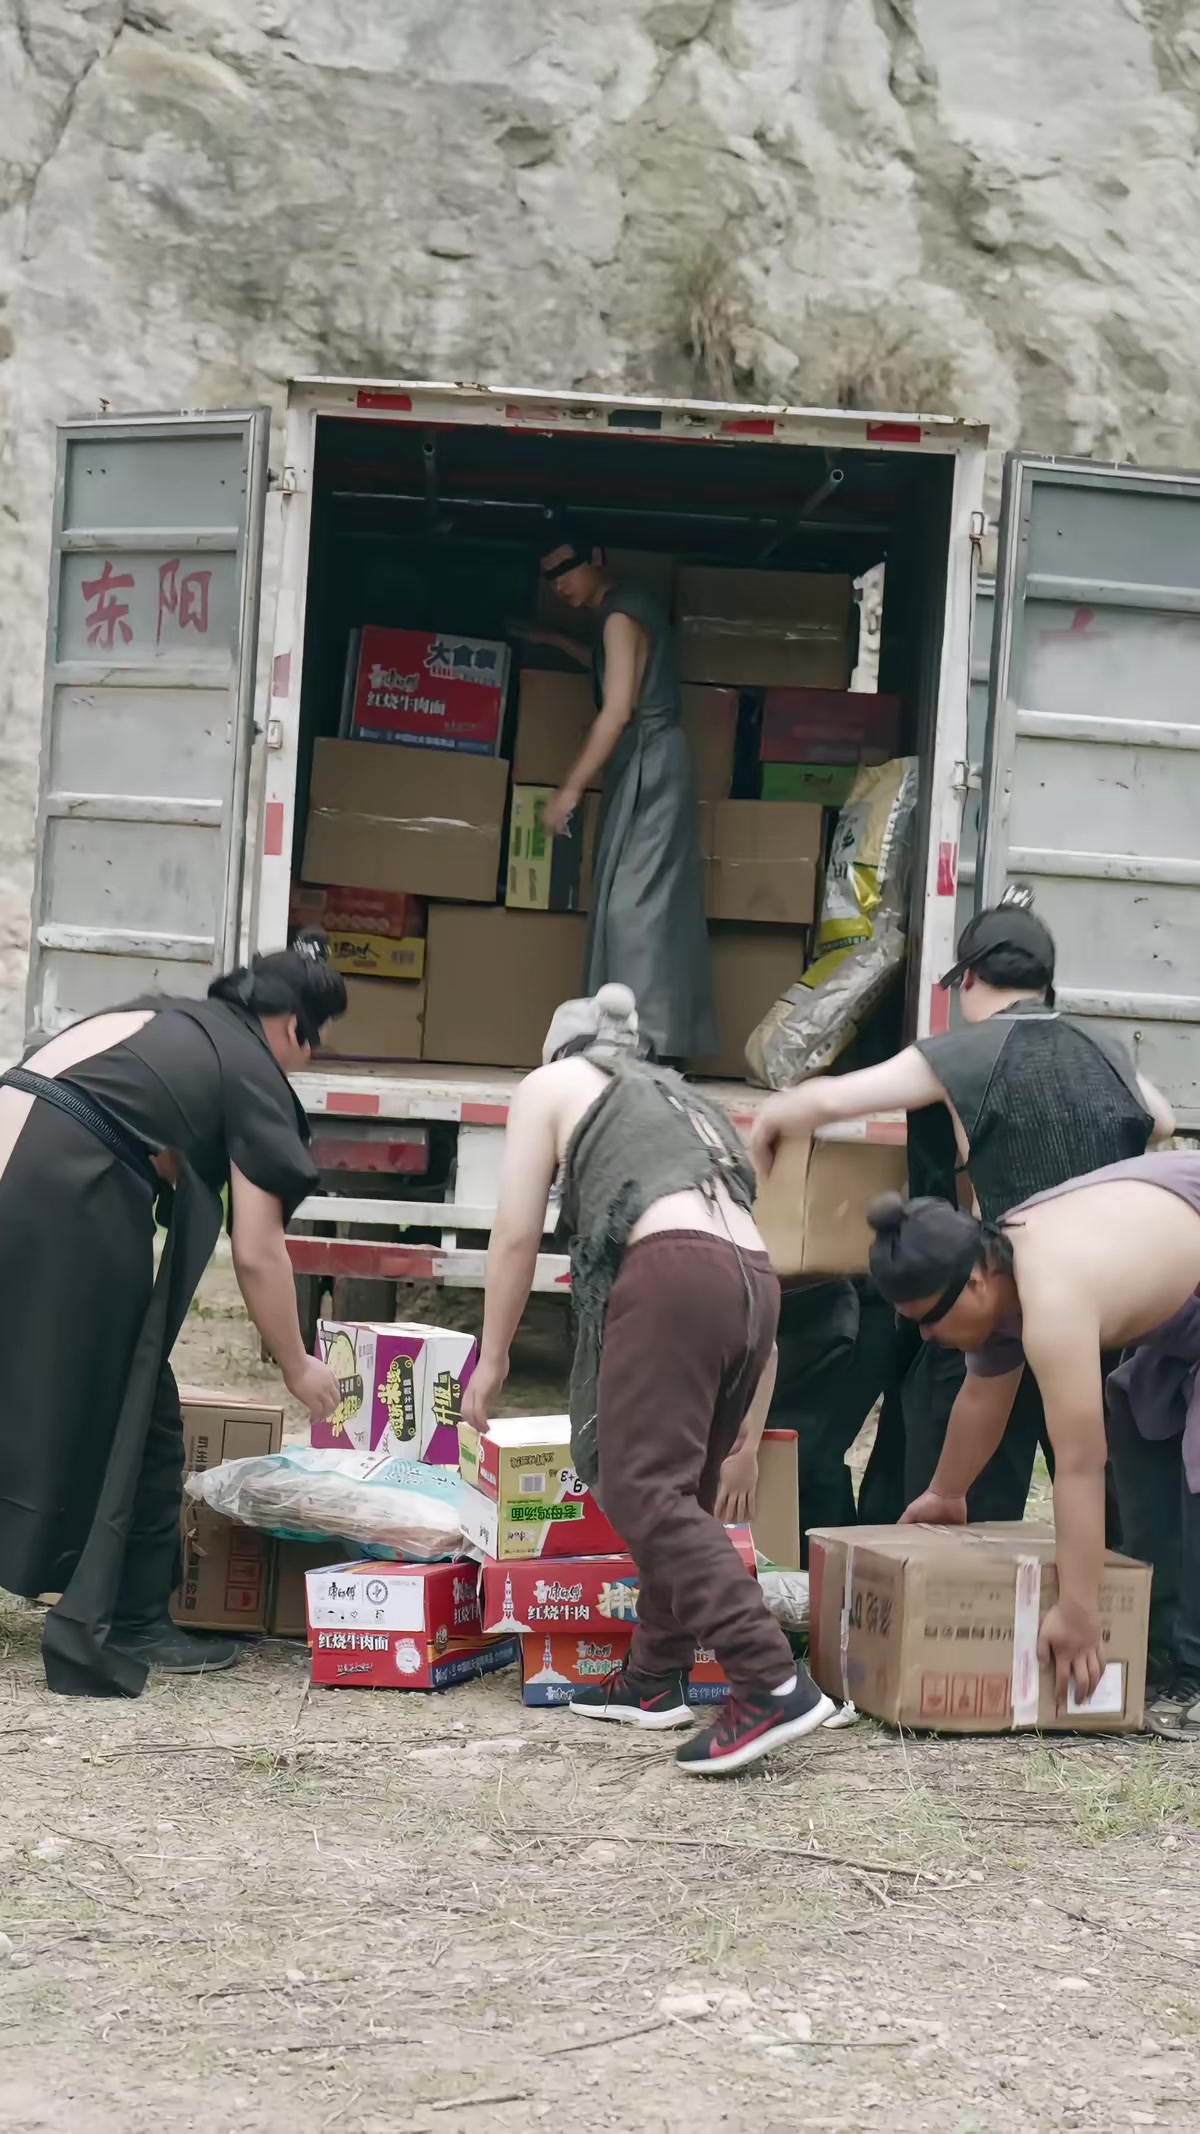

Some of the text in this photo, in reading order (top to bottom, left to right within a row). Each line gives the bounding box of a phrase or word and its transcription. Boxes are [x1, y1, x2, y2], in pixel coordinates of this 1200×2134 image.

[82, 559, 212, 649] 东阳
[367, 691, 446, 716] 红烧牛肉面
[453, 1383, 461, 1398] 4.0
[511, 1505, 577, 1522] 老母鸡汤面
[527, 1605, 590, 1621] 红烧牛肉
[318, 1633, 389, 1651] 红烧牛肉面
